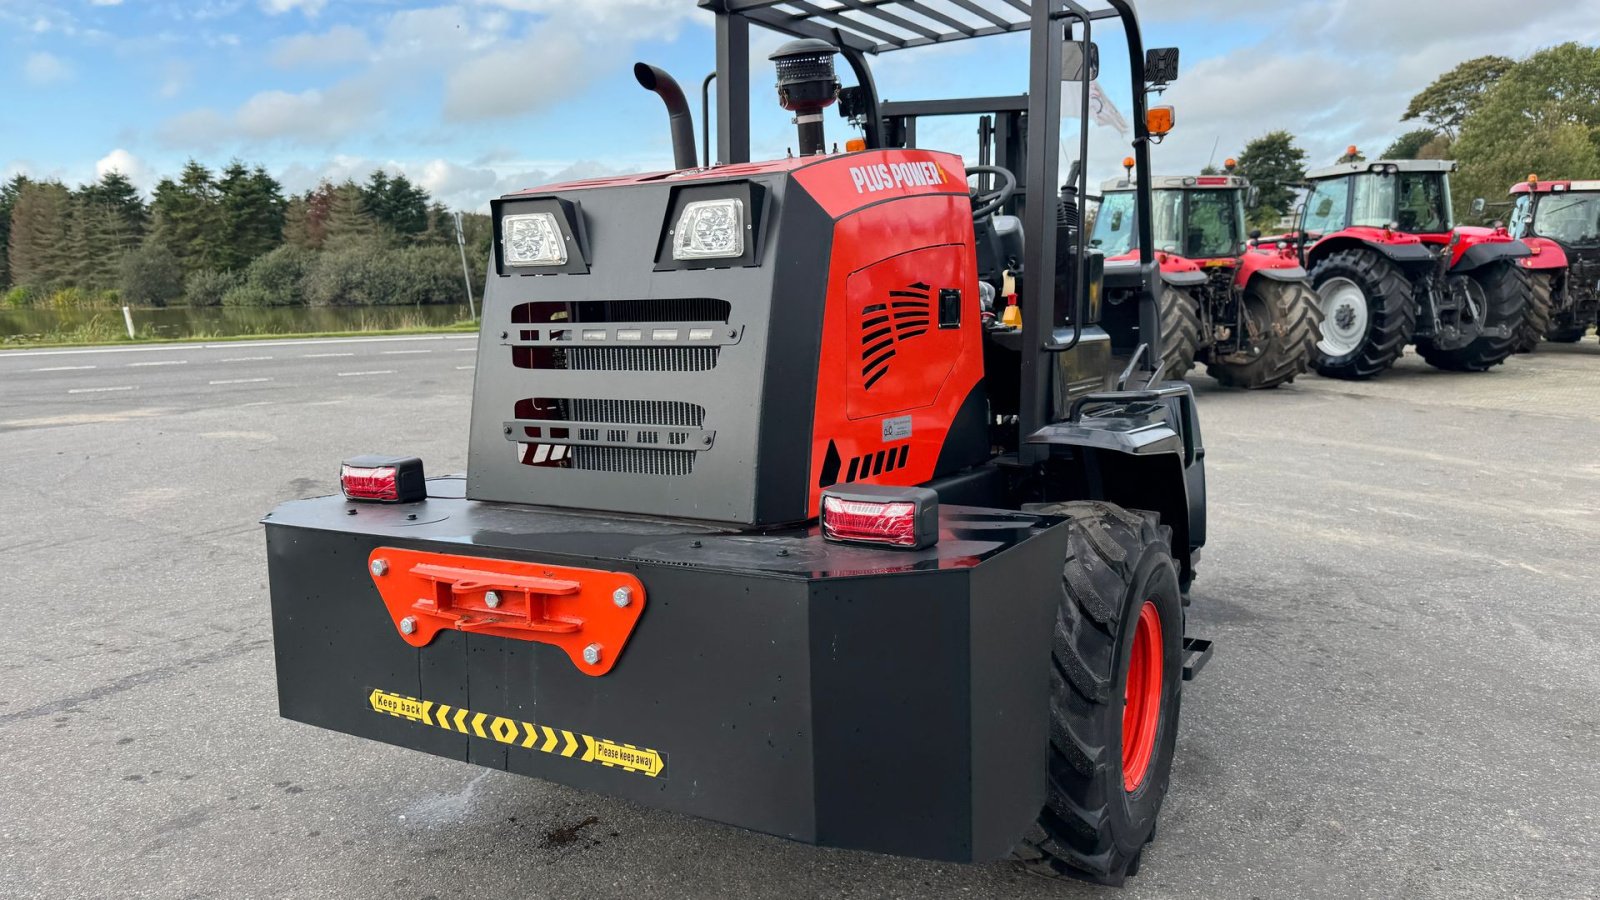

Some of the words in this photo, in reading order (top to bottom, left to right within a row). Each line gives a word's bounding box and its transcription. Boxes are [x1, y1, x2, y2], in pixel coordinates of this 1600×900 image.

[849, 163, 894, 194] PLUS
[890, 161, 942, 189] POWER
[377, 695, 398, 711] Keep
[401, 701, 421, 715] back
[598, 744, 619, 759] Please
[619, 748, 634, 765] keep
[635, 755, 653, 769] away
